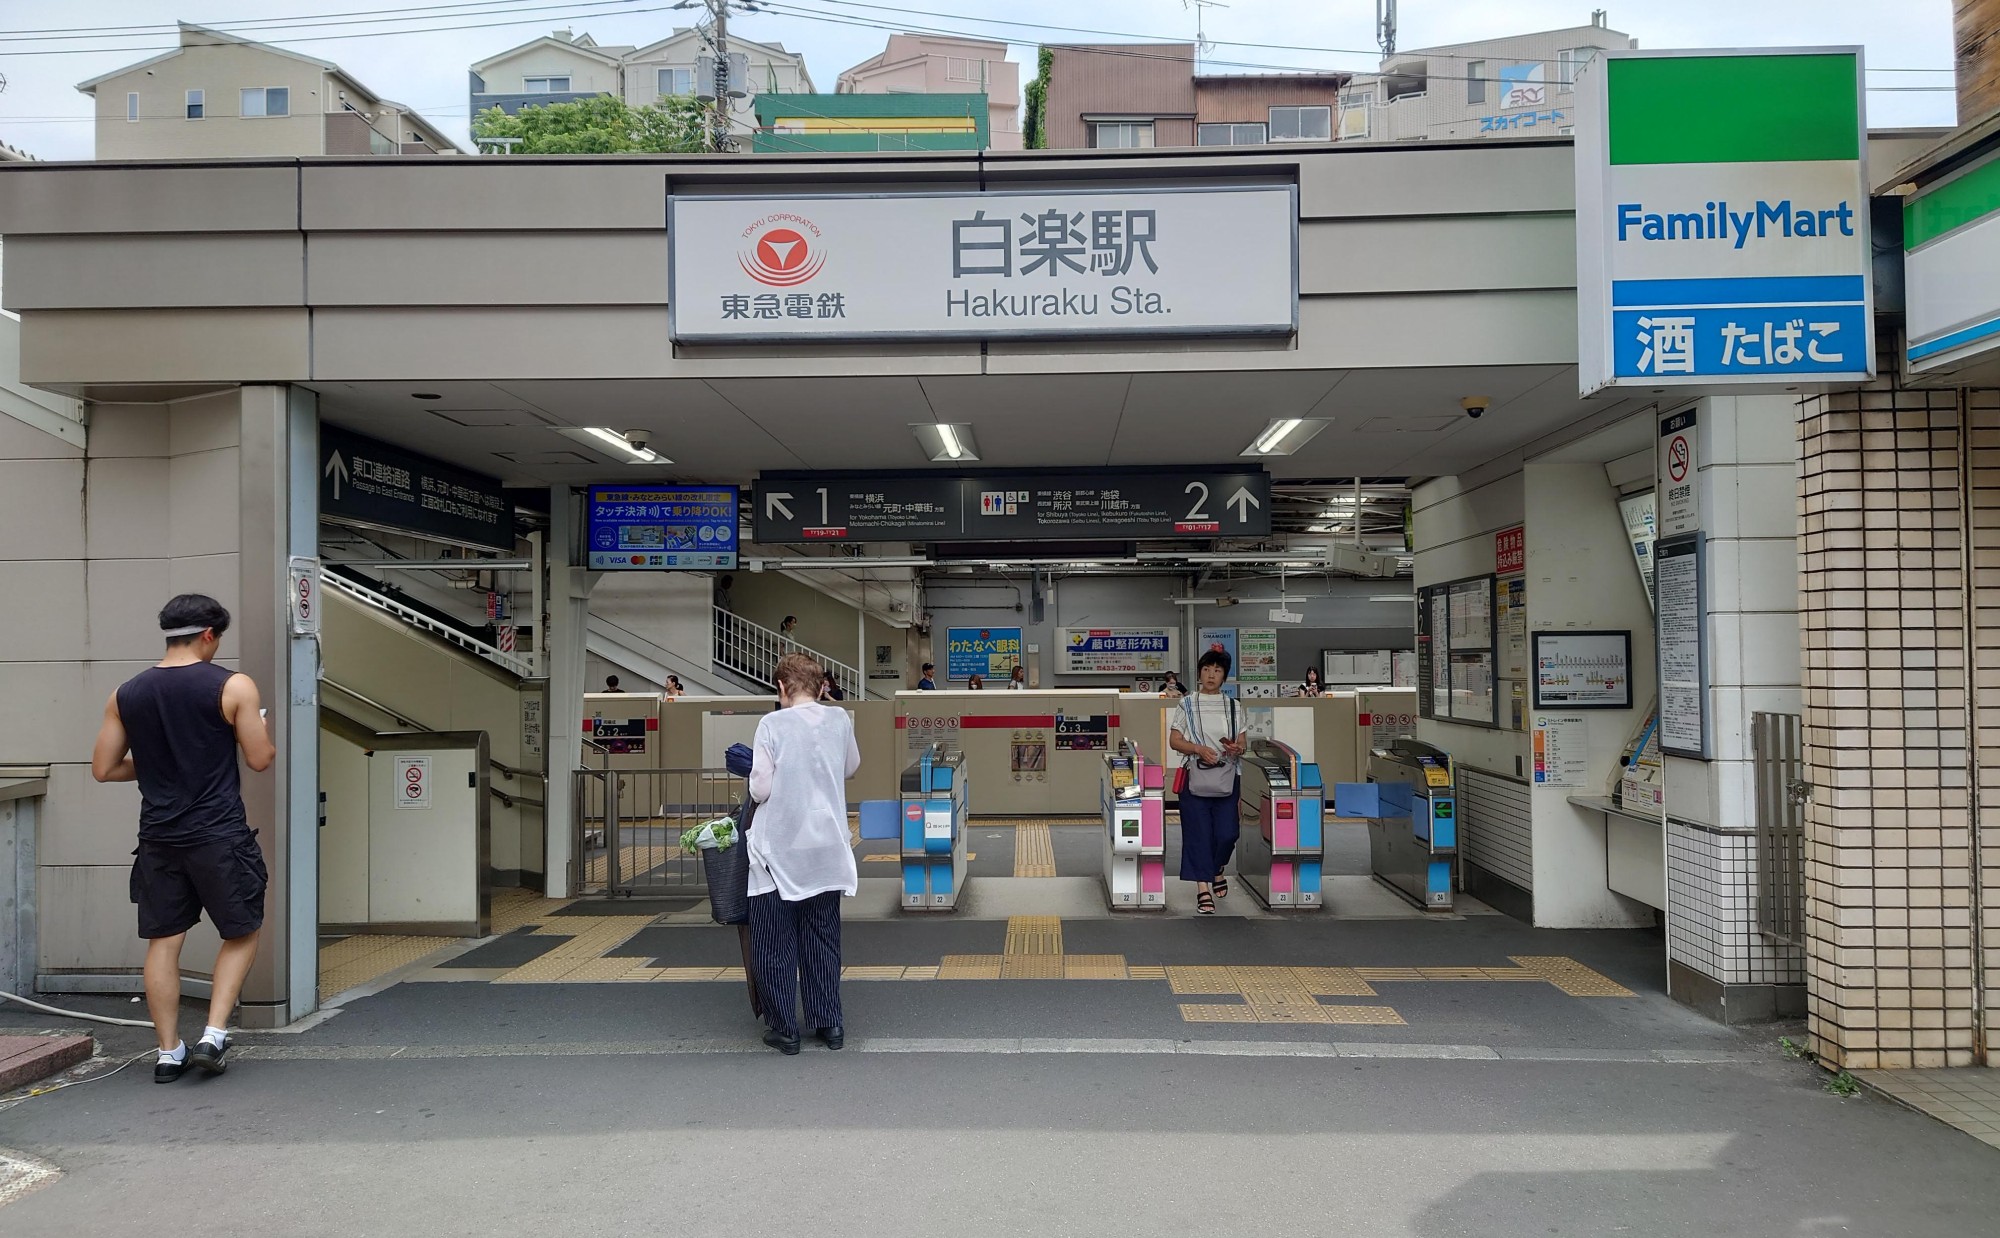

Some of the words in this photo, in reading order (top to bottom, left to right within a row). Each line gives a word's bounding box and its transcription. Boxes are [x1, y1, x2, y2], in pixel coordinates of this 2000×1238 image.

[1481, 109, 1564, 132] スカイコート
[742, 218, 765, 239] TOKYU
[768, 213, 822, 238] CORPORATION
[1618, 200, 1854, 249] FamilyMart
[952, 208, 1159, 278] 白楽駅
[720, 292, 846, 320] 東急電鉄
[946, 288, 1098, 317] Hakuraku
[1110, 286, 1172, 314] Sta.
[1636, 316, 1696, 374] 酒
[1721, 318, 1843, 366] たばこ
[352, 456, 410, 490] 東口連絡通路
[352, 478, 375, 494] Passage
[376, 484, 381, 494] to
[382, 485, 393, 498] East
[394, 488, 414, 502] Entrance
[865, 494, 884, 503] 横浜
[1053, 490, 1072, 500] 渋谷
[1100, 490, 1120, 500] 池袋
[1668, 484, 1691, 501] 終日禁煙
[595, 506, 646, 517] タッチ決済
[816, 488, 828, 524] 1
[883, 503, 932, 513] 元町・中華街
[1053, 501, 1072, 510] 所沢
[1100, 500, 1129, 510] 川越市
[1184, 482, 1209, 520] 2
[1497, 532, 1522, 552] 危険物品
[950, 639, 1020, 653] わたなべ眼科
[1092, 638, 1163, 650] 藤中整形外科
[597, 726, 604, 736] 6
[613, 728, 619, 736] 2
[1059, 722, 1066, 732] 6
[1075, 724, 1080, 732] 3
